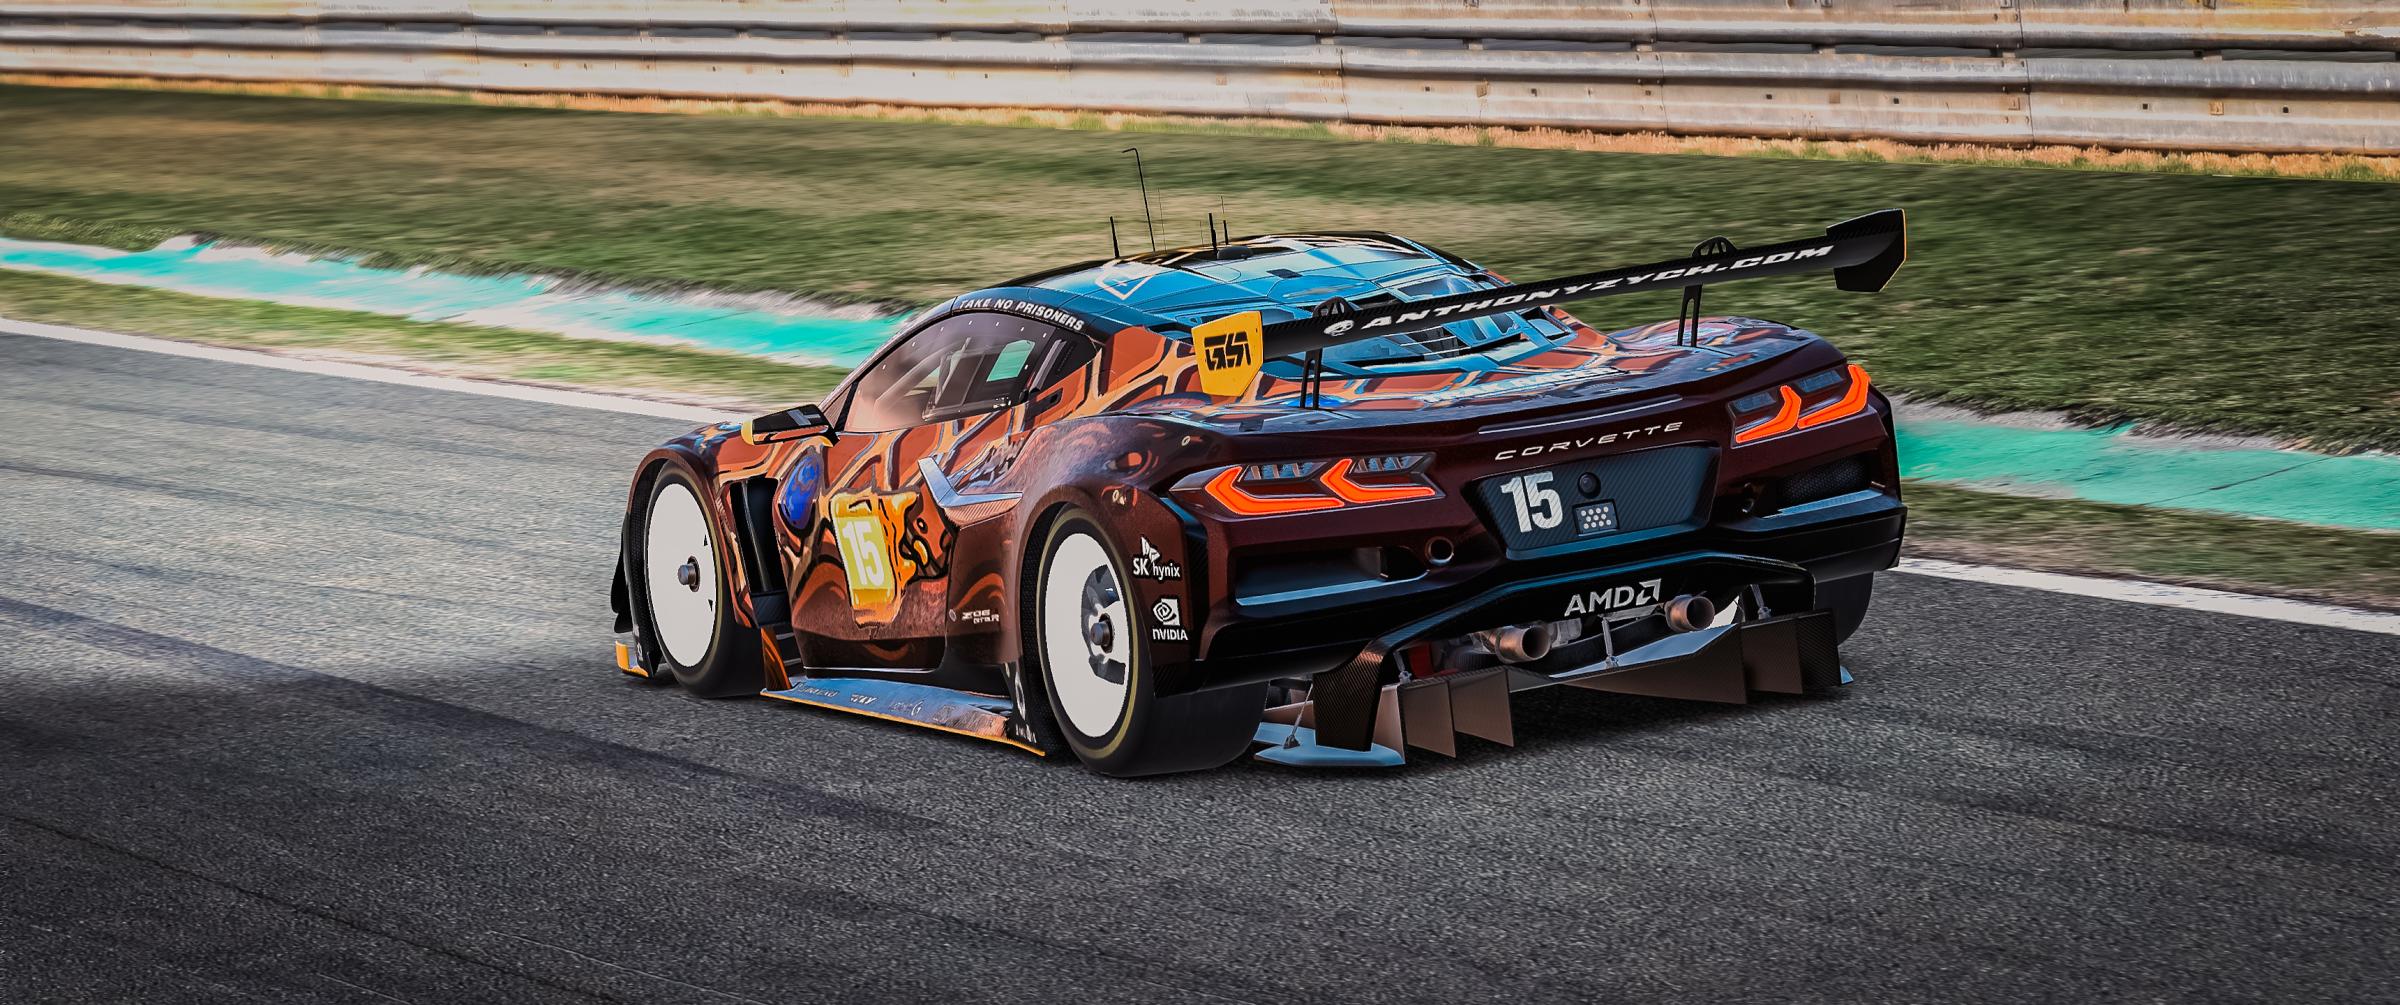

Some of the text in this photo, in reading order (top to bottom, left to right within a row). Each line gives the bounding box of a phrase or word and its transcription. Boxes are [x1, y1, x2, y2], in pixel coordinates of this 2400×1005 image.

[1361, 245, 1834, 330] ANTHONYZYCH.COM
[959, 297, 1085, 331] TAKE NO PRISONERS
[1495, 421, 1683, 461] CORVETTE
[1500, 471, 1564, 533] 15
[842, 521, 885, 586] 15
[1133, 558, 1181, 581] SK hynix
[1564, 586, 1635, 617] AMD
